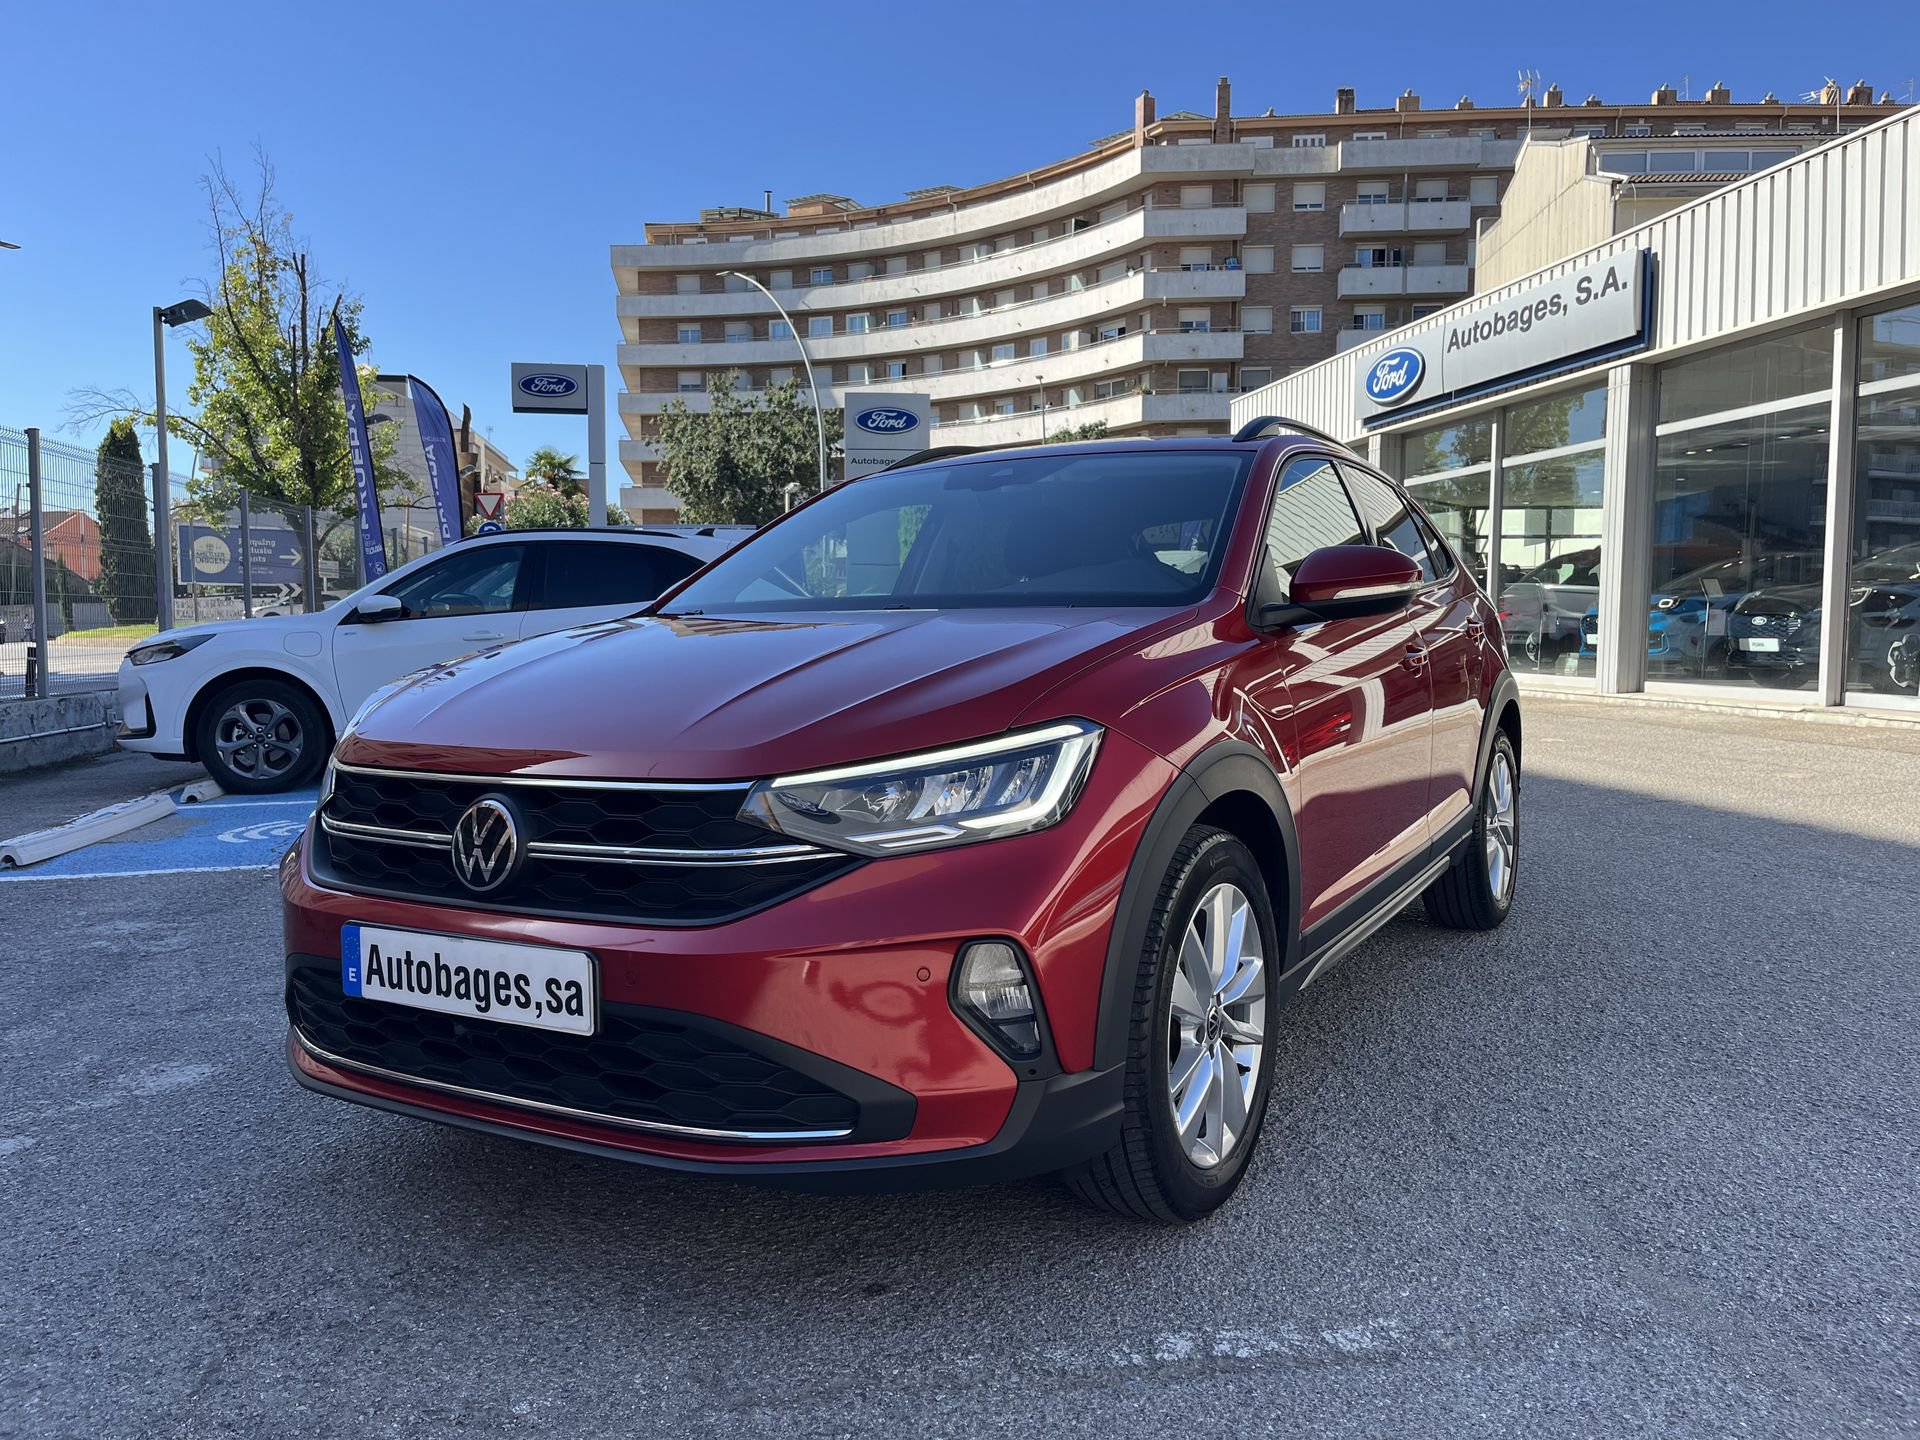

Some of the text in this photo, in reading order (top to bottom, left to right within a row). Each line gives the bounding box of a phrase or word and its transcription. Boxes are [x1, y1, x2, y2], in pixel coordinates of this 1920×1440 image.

[1447, 266, 1627, 353] Autobages, S.A.
[1372, 357, 1409, 393] Ford
[531, 377, 566, 392] Ford
[867, 411, 907, 428] Ford
[850, 457, 897, 467] Autobage
[349, 967, 358, 982] E
[365, 944, 584, 1018] Autobages,sa
